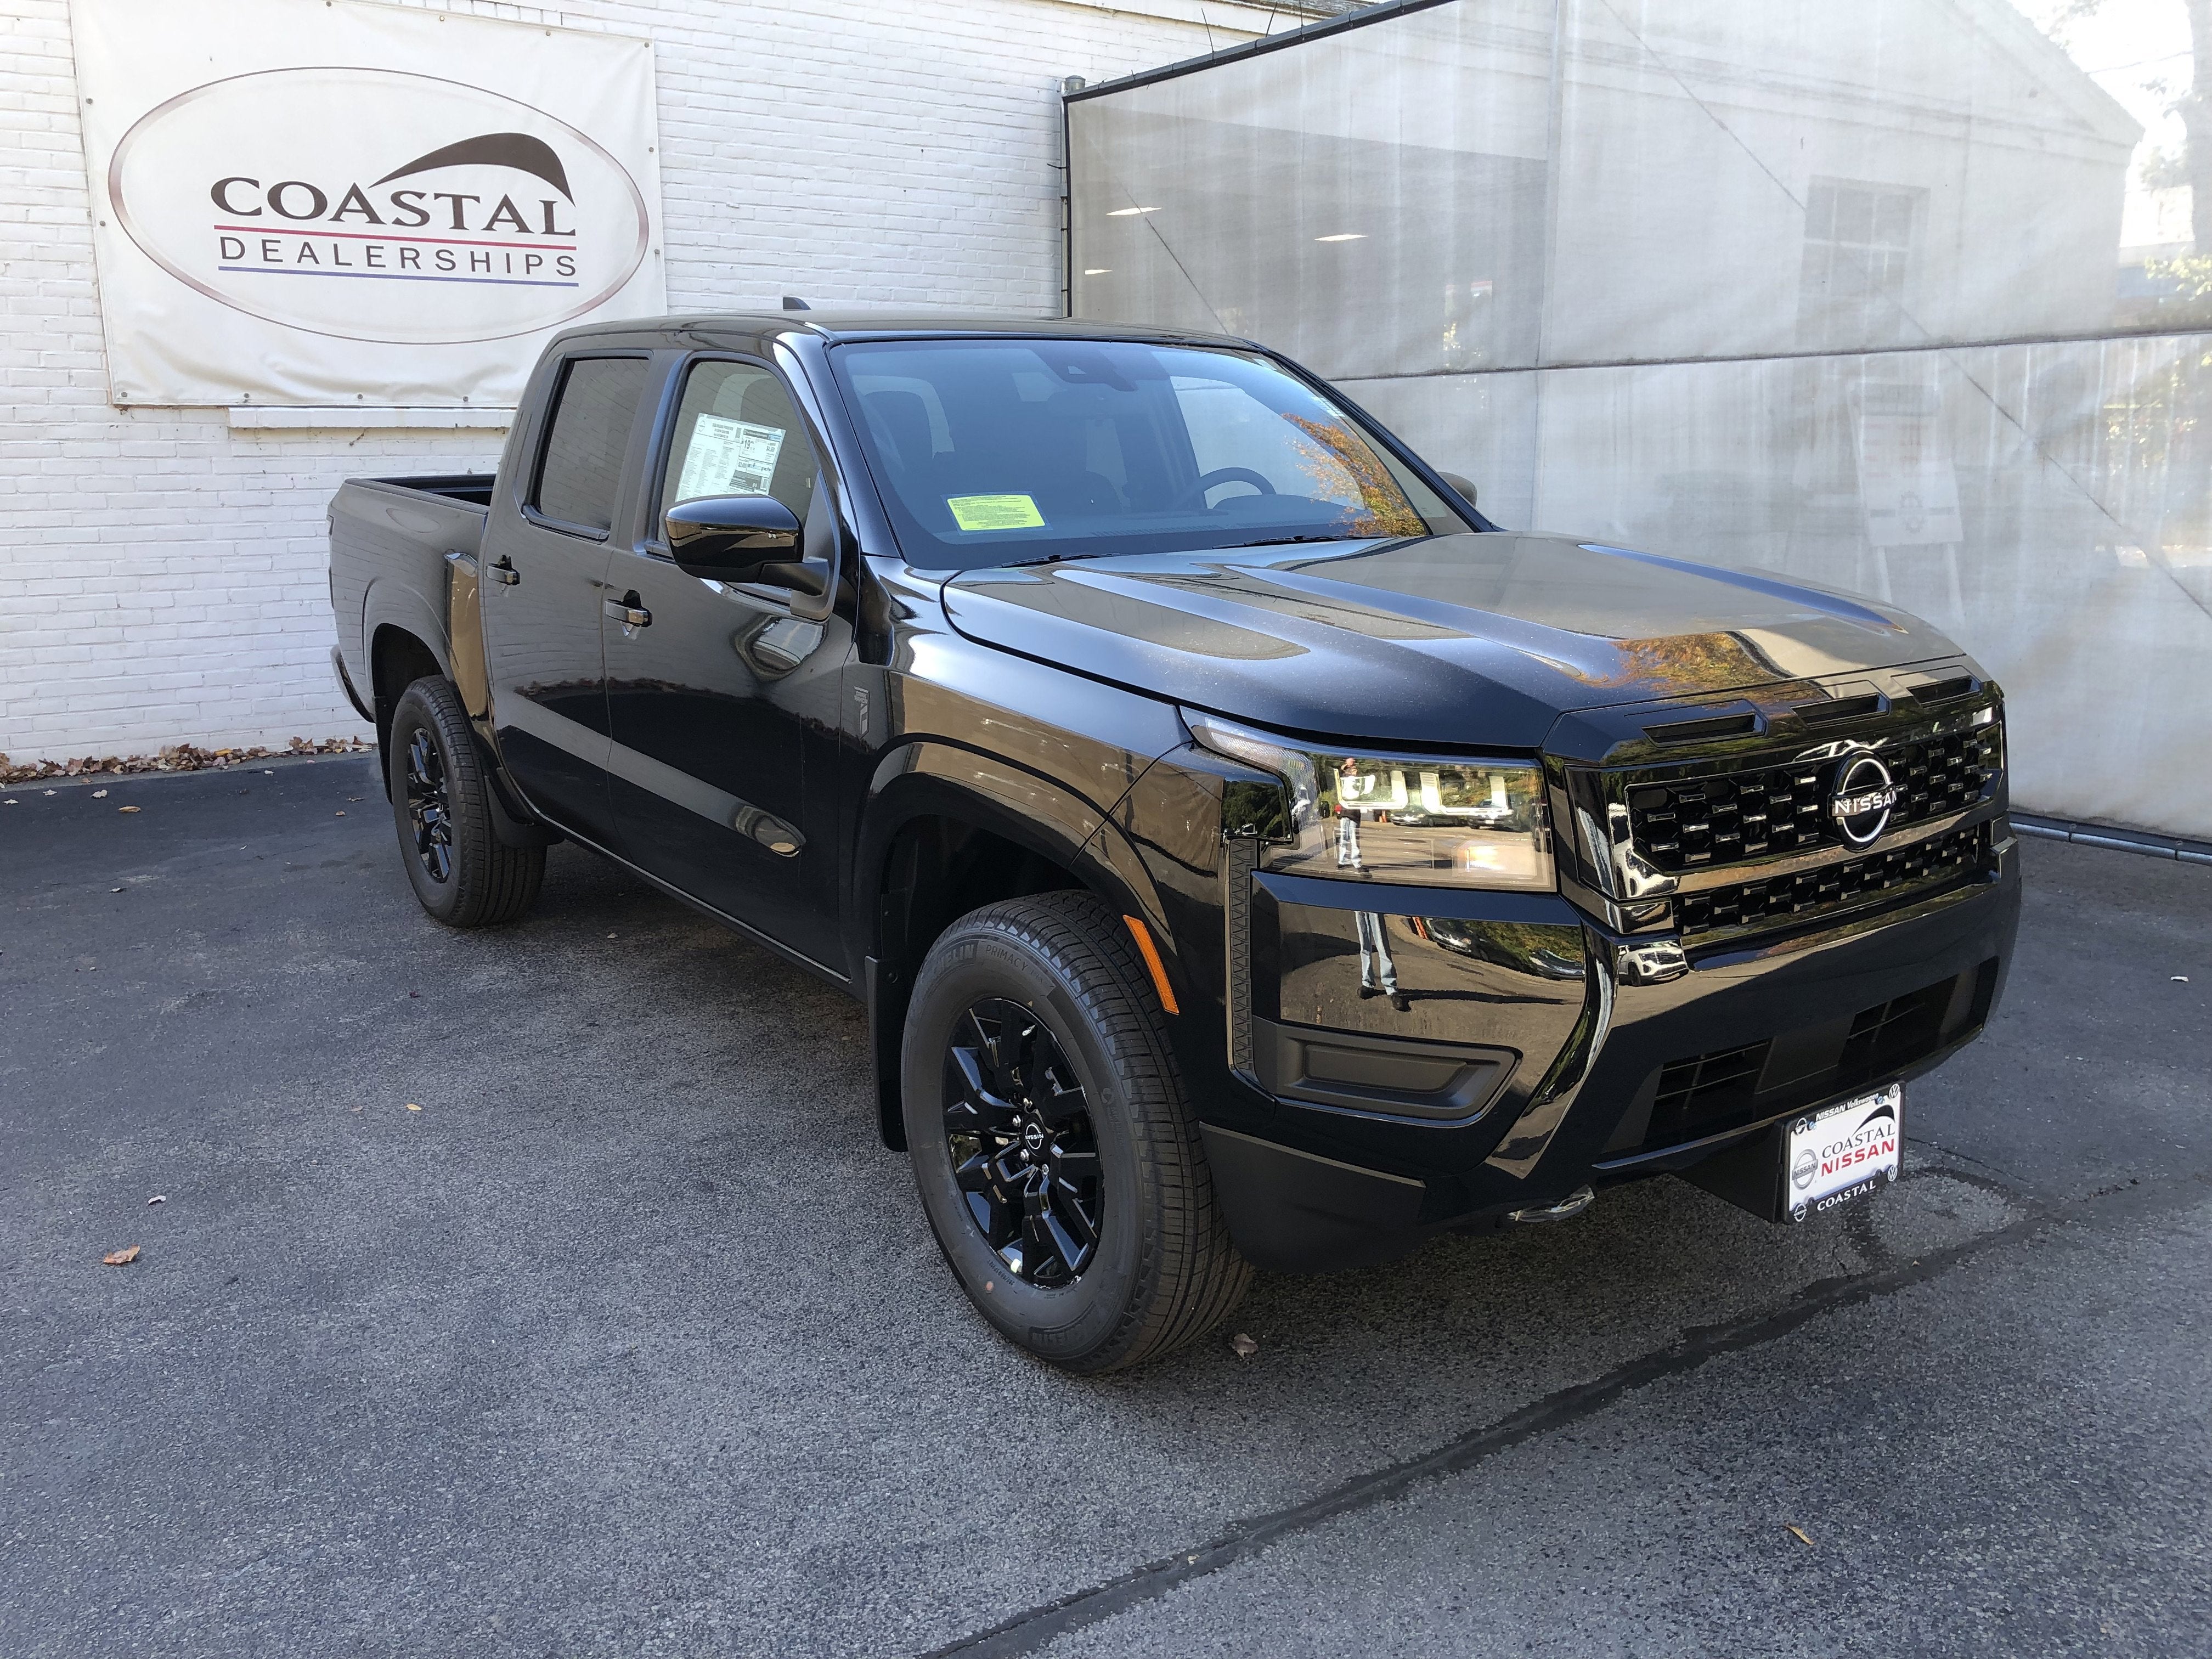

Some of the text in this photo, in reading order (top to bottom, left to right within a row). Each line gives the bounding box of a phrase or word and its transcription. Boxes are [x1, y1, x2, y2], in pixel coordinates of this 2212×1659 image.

[211, 177, 576, 236] COASTAL
[220, 236, 576, 276] DEALERSHIPS
[1834, 790, 1897, 814] NISSAN
[986, 944, 1028, 971] PRIMACY
[1815, 1093, 1880, 1122] NISSAN Volkswagen
[1822, 1124, 1896, 1158] COASTAL
[1793, 1162, 1816, 1177] NISSAN
[1821, 1138, 1894, 1177] NISSAN
[1817, 1180, 1876, 1212] COASTAL
